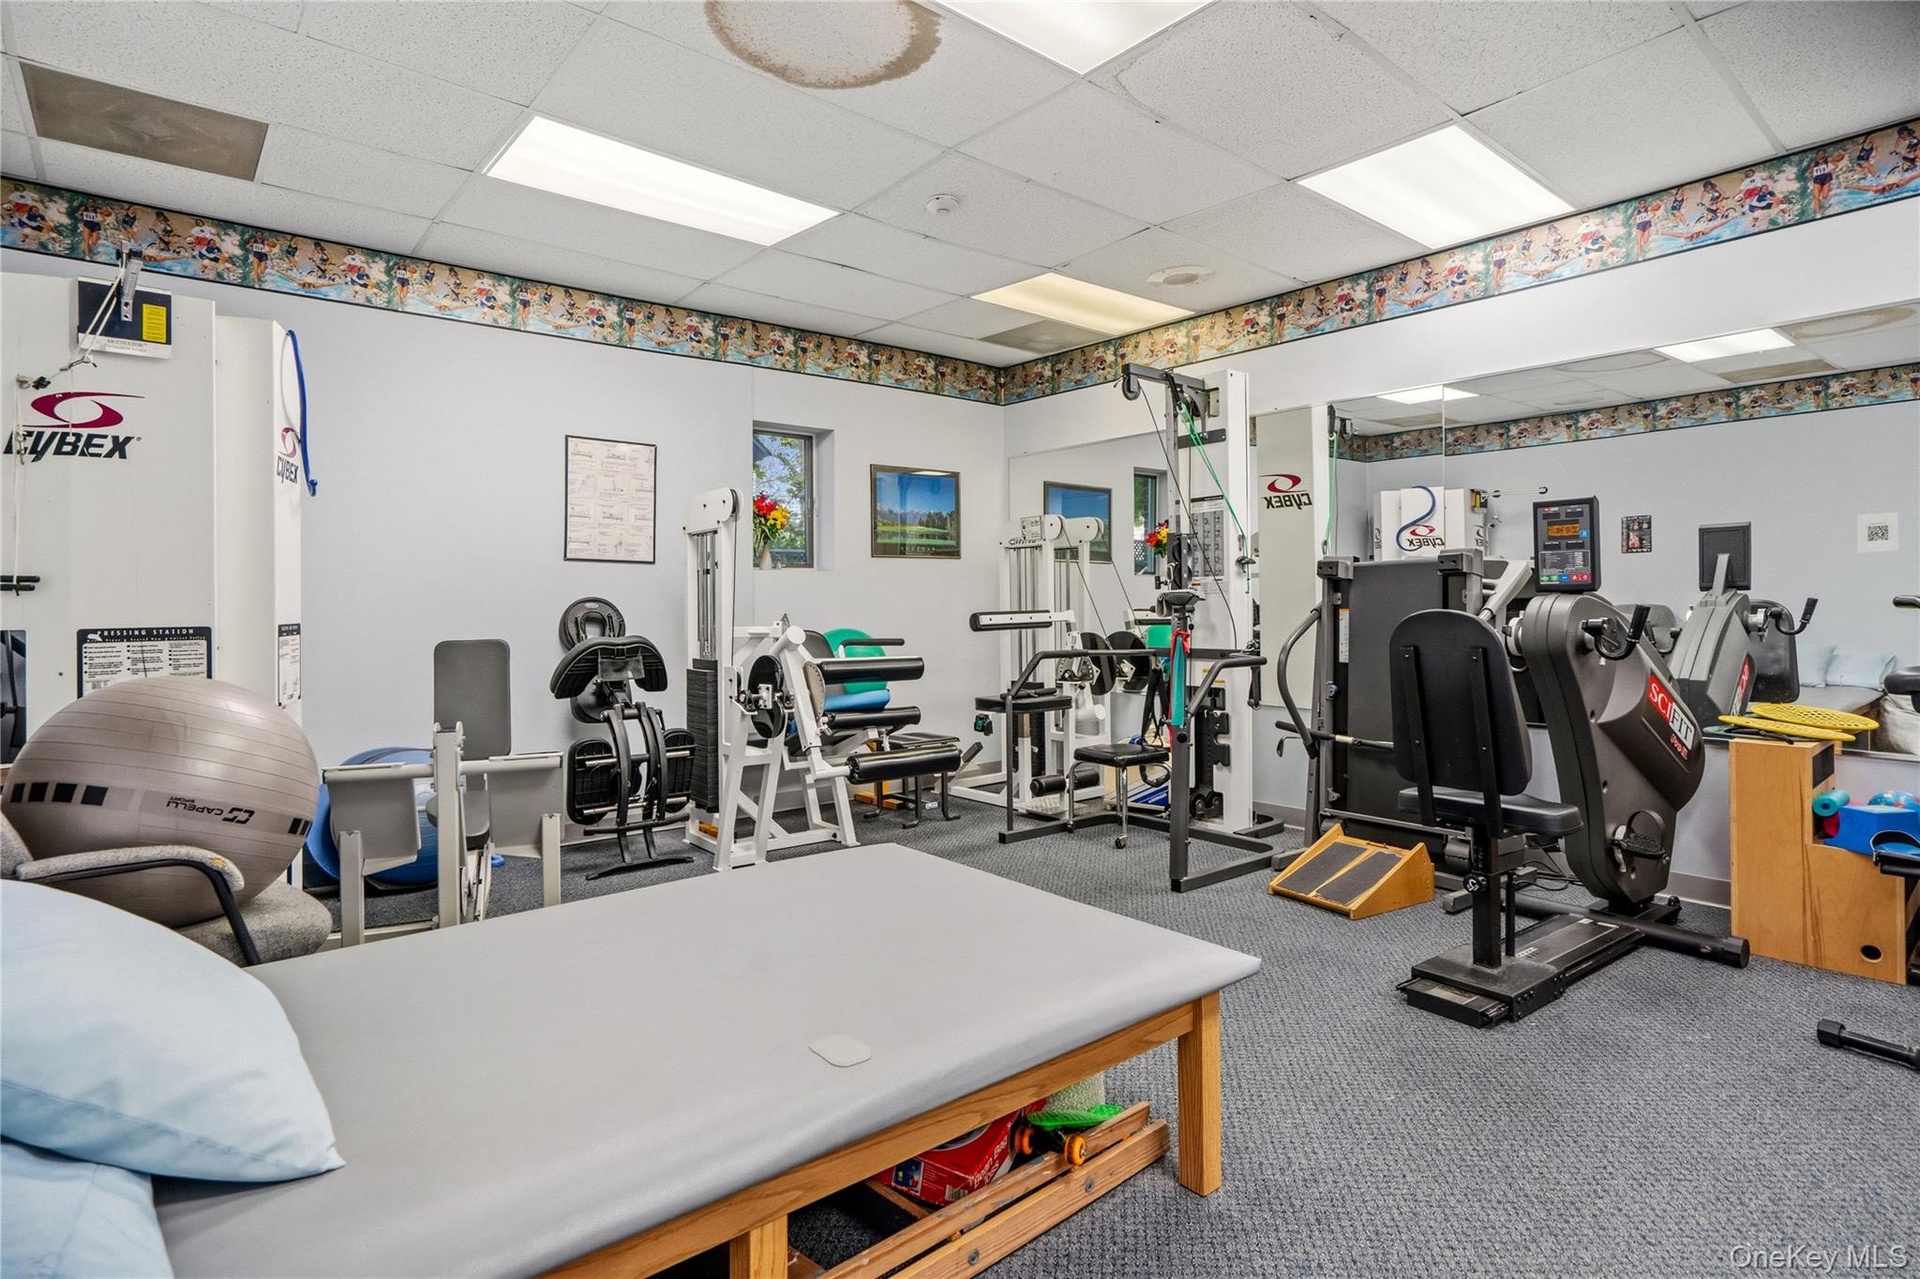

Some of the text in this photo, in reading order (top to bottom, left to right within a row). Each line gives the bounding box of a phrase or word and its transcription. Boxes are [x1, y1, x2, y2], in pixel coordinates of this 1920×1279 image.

[3, 430, 135, 462] CYBEX
[276, 455, 299, 484] CYBEX
[166, 801, 224, 816] CAPELLI
